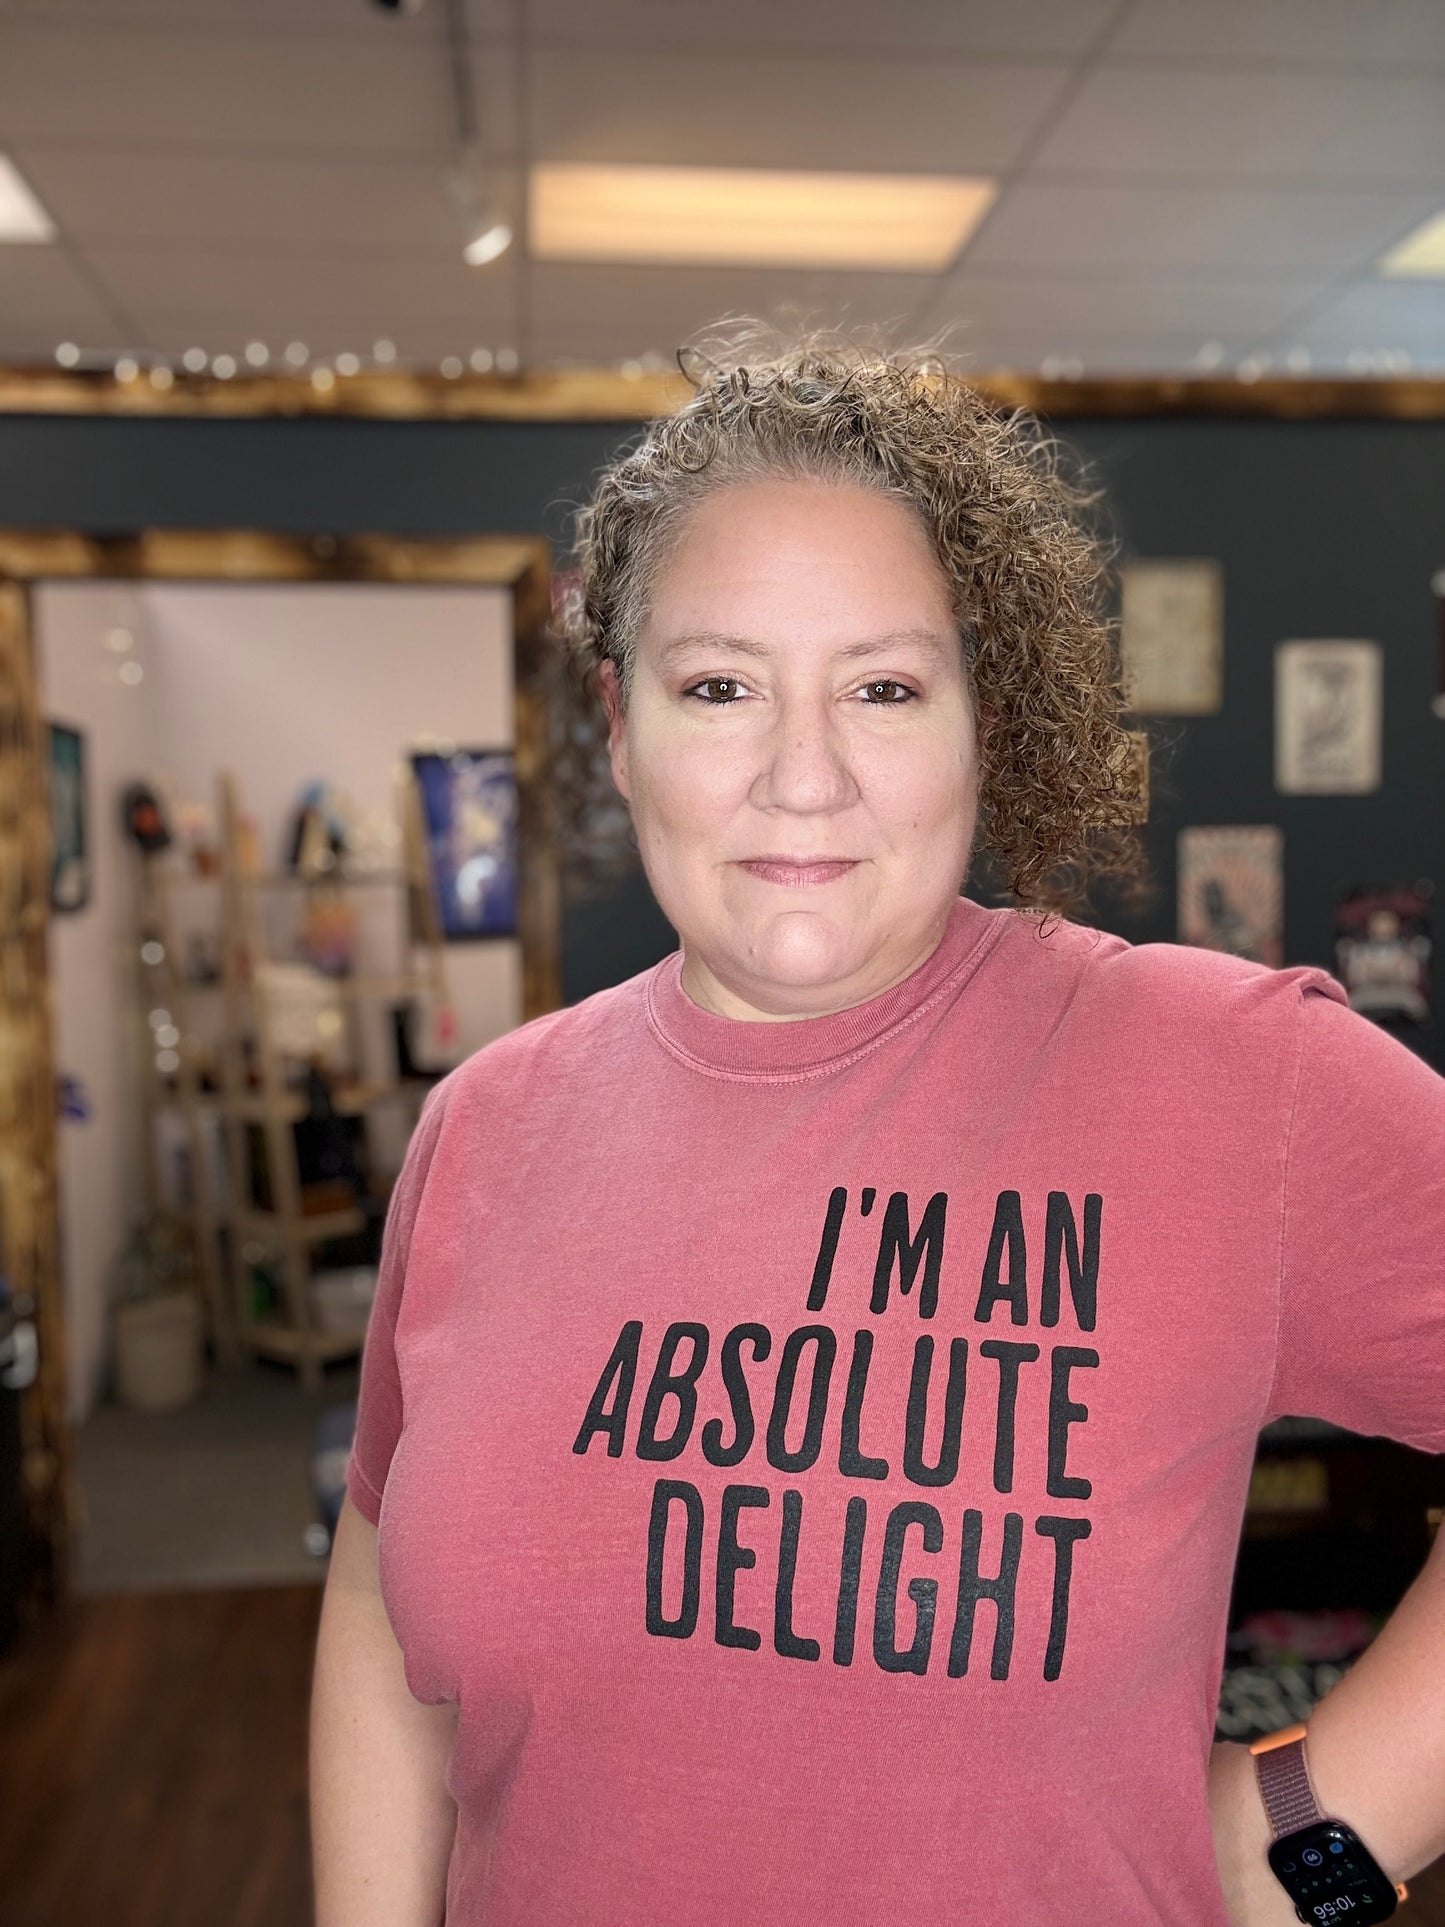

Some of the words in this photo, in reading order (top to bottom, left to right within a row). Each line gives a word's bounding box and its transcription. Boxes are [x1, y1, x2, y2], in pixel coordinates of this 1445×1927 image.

[806, 1186, 949, 1320] I'M
[973, 1189, 1103, 1333] AN
[572, 1320, 1100, 1501] ABSOLUTE
[645, 1478, 1092, 1682] DELIGHT
[1314, 1895, 1356, 1919] 10:56
